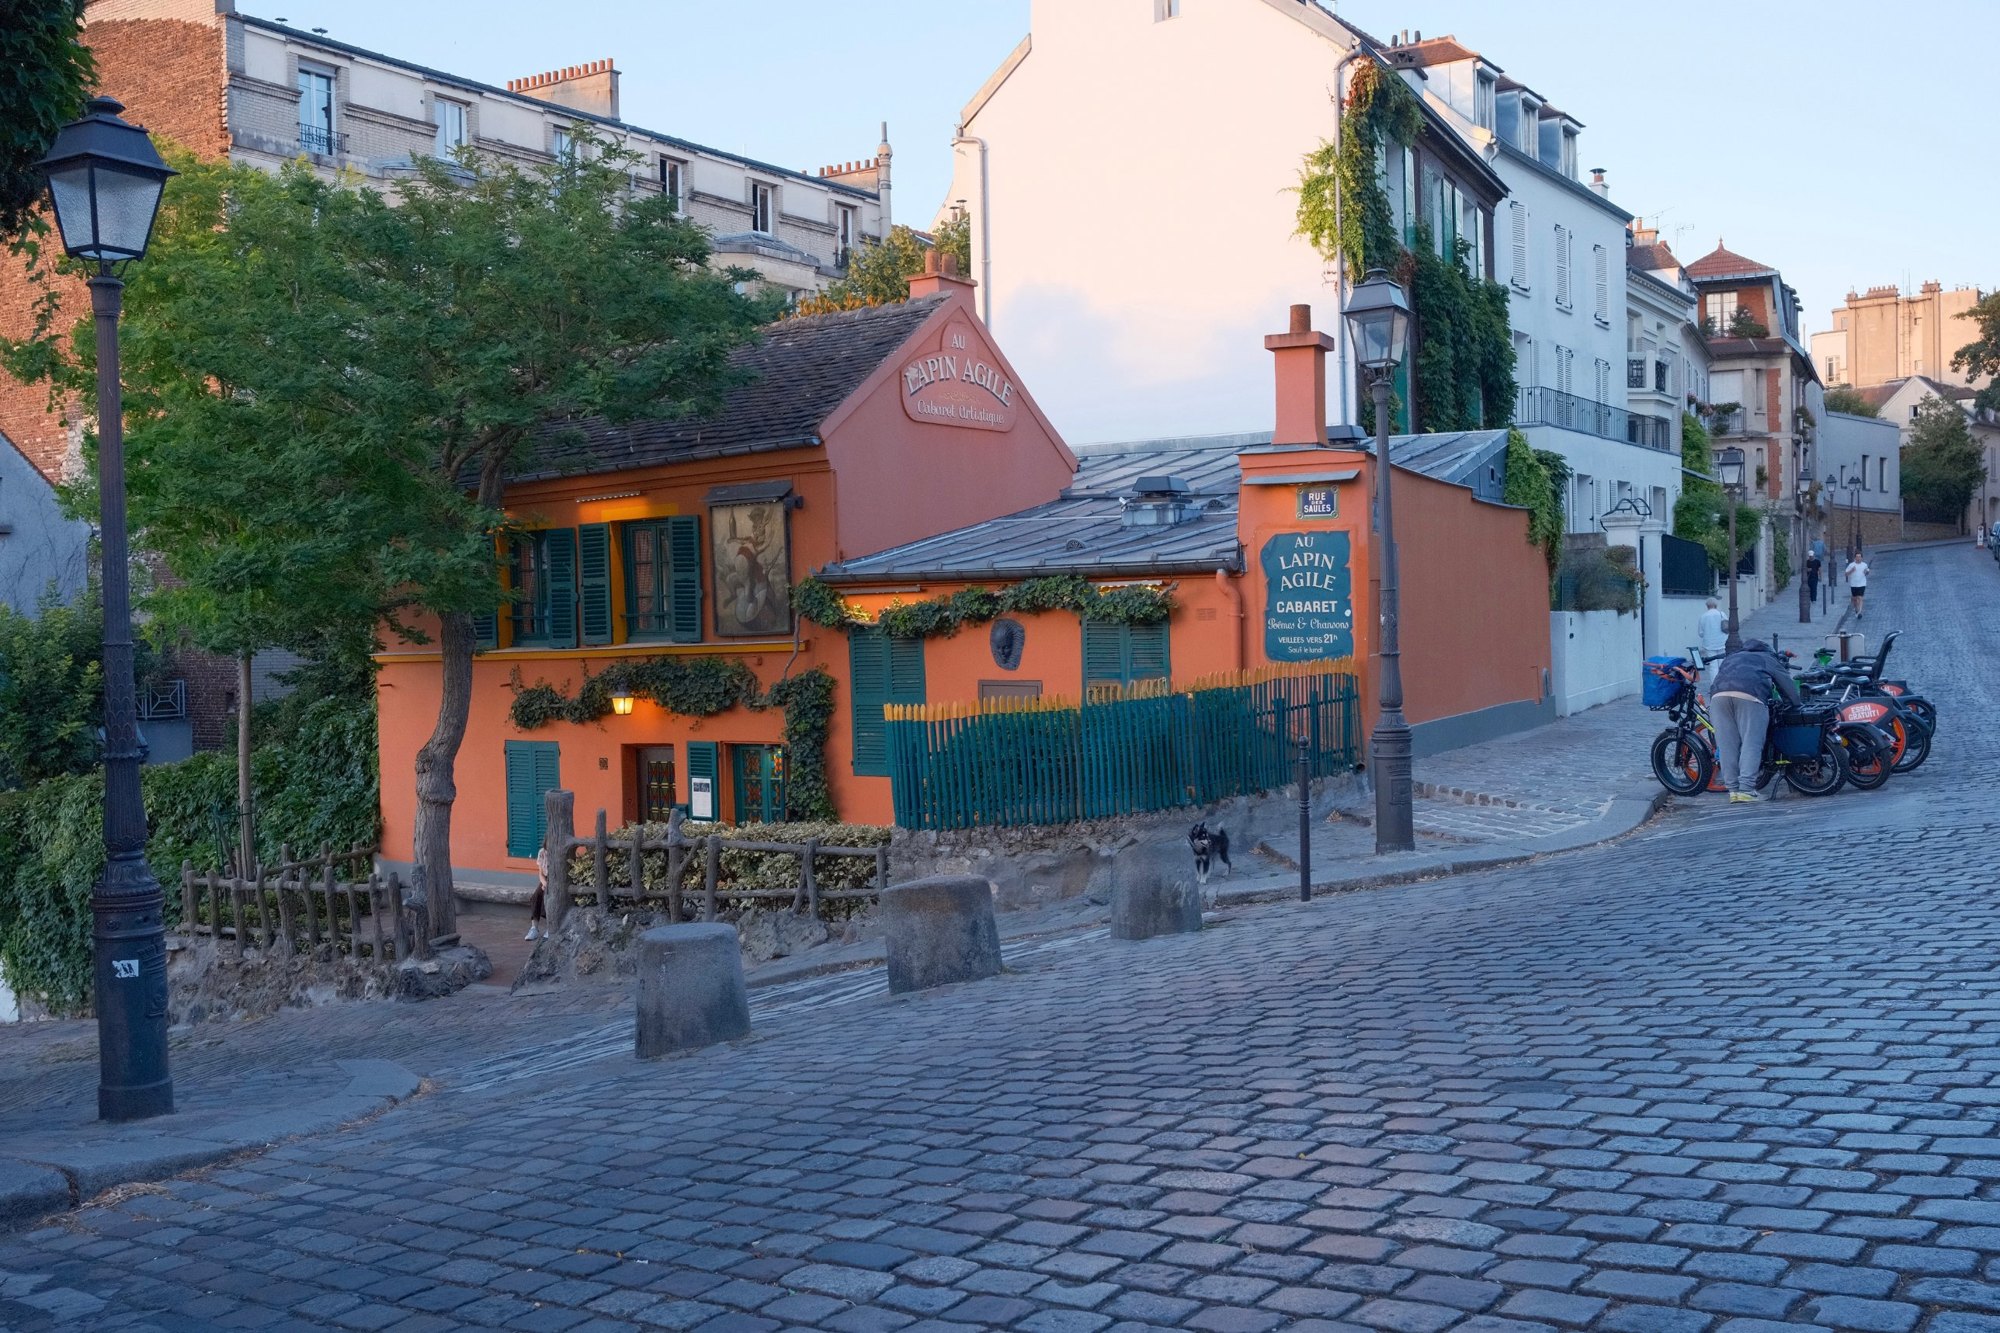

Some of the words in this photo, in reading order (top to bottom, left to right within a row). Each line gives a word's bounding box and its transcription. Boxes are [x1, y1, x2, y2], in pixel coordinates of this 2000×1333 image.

[952, 333, 966, 350] AU
[904, 356, 957, 396] LAPIN
[961, 358, 1013, 408] AGILE
[917, 400, 956, 417] Cabaret
[1308, 492, 1326, 501] RUE
[1303, 504, 1331, 513] SAULES
[1294, 537, 1314, 549] AU
[1279, 552, 1335, 570] LAPIN
[1280, 572, 1336, 592] AGILE
[1276, 601, 1338, 613] CABARET
[1297, 616, 1307, 630] &
[1310, 618, 1349, 630] Chansons
[1306, 636, 1322, 644] VERS
[1324, 633, 1338, 644] 21h
[1288, 646, 1302, 654] Sauf
[1851, 704, 1871, 713] ESSAI
